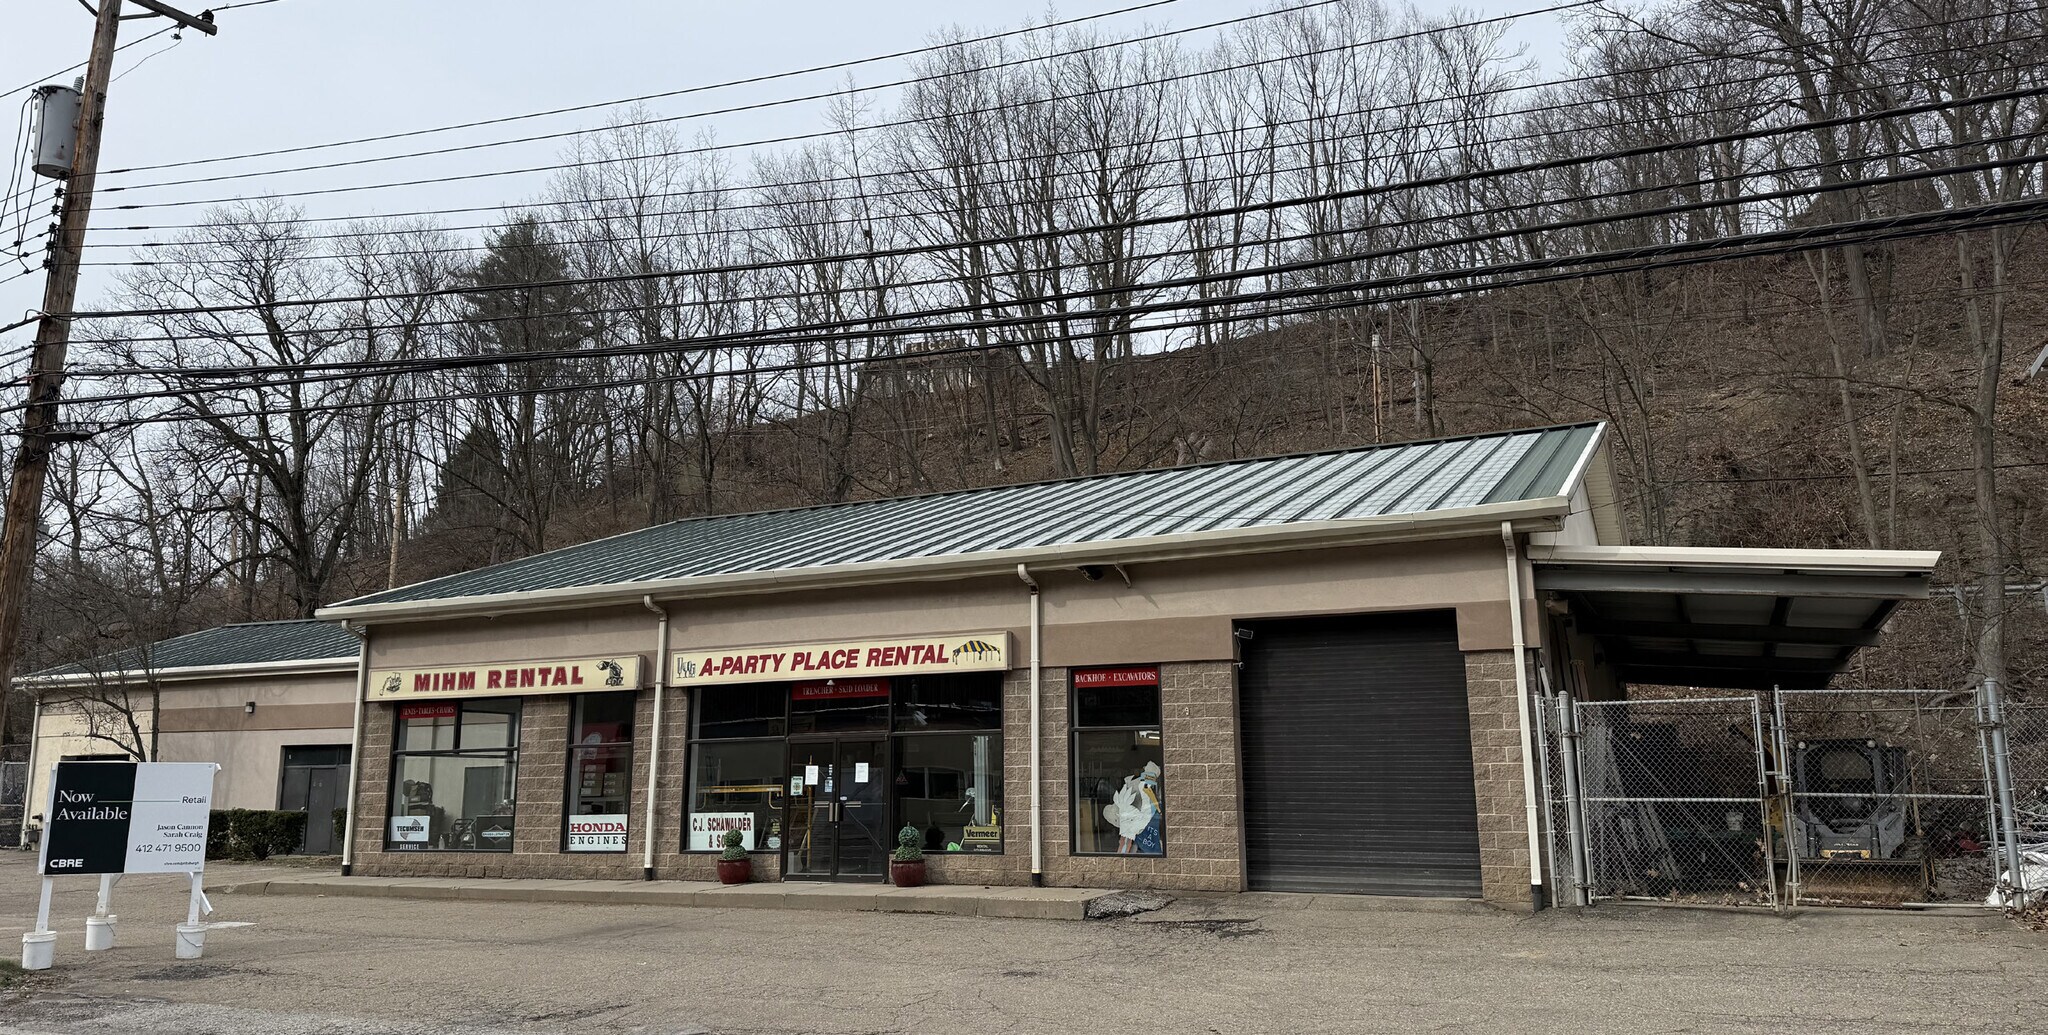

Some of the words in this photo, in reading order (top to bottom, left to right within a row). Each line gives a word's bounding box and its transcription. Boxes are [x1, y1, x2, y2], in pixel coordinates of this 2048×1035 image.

[699, 653, 786, 677] A-PARTY
[790, 649, 860, 671] PLACE
[866, 644, 949, 667] RENTAL
[413, 671, 476, 692] MIHM
[487, 665, 584, 689] RENTAL
[1113, 671, 1156, 682] EXCAVATORS
[802, 686, 834, 695] TRENCHER
[58, 789, 95, 803] Now
[182, 796, 207, 804] Retail
[56, 806, 128, 820] Available
[569, 822, 626, 833] HONDA
[707, 817, 752, 832] SCHAWALDER
[184, 831, 203, 839] Craig
[965, 829, 998, 838] Vermeer
[570, 836, 627, 845] ENGINES
[708, 834, 713, 848] &
[135, 844, 153, 853] 412
[155, 843, 172, 852] 471
[174, 843, 201, 852] 9500
[49, 858, 84, 868] CBRE
